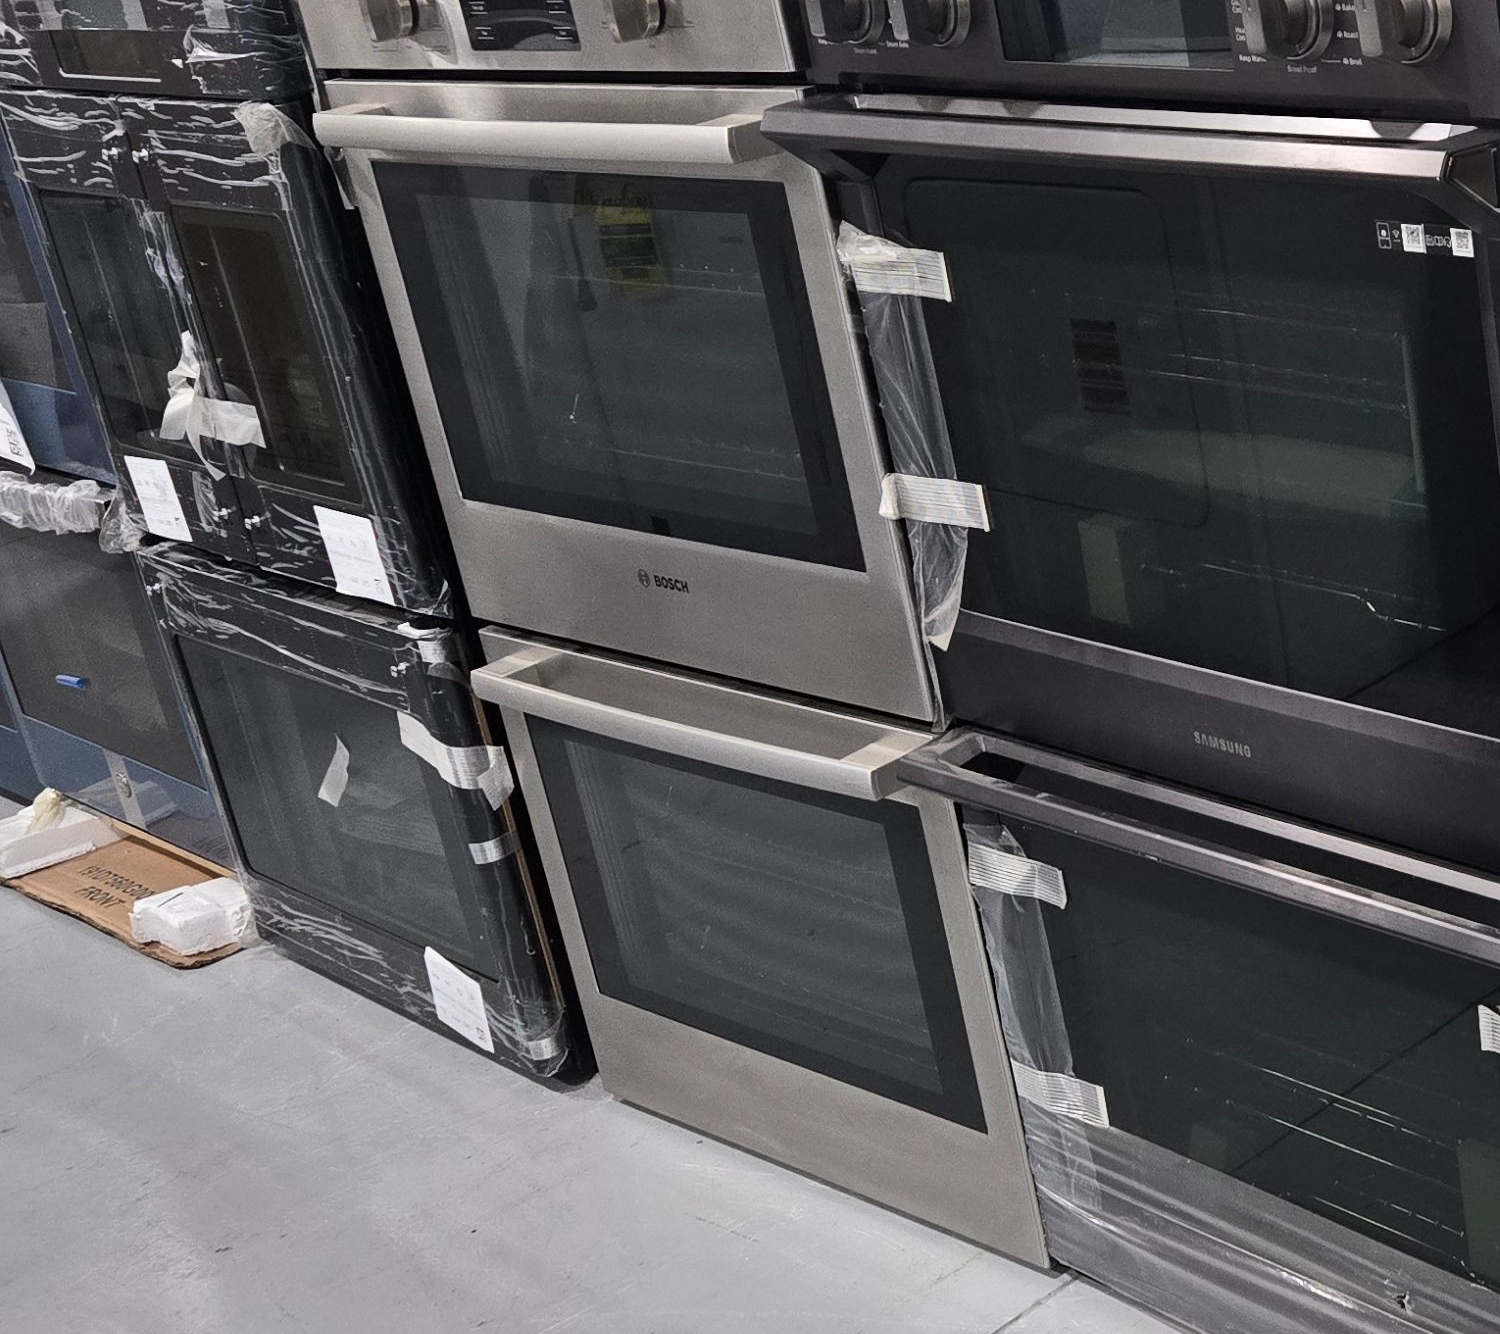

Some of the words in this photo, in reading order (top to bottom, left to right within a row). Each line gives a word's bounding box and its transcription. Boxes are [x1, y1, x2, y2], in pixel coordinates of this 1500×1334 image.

[654, 574, 690, 594] BOSCH
[1193, 730, 1252, 758] SAMSUNG
[74, 885, 126, 909] FRONT
